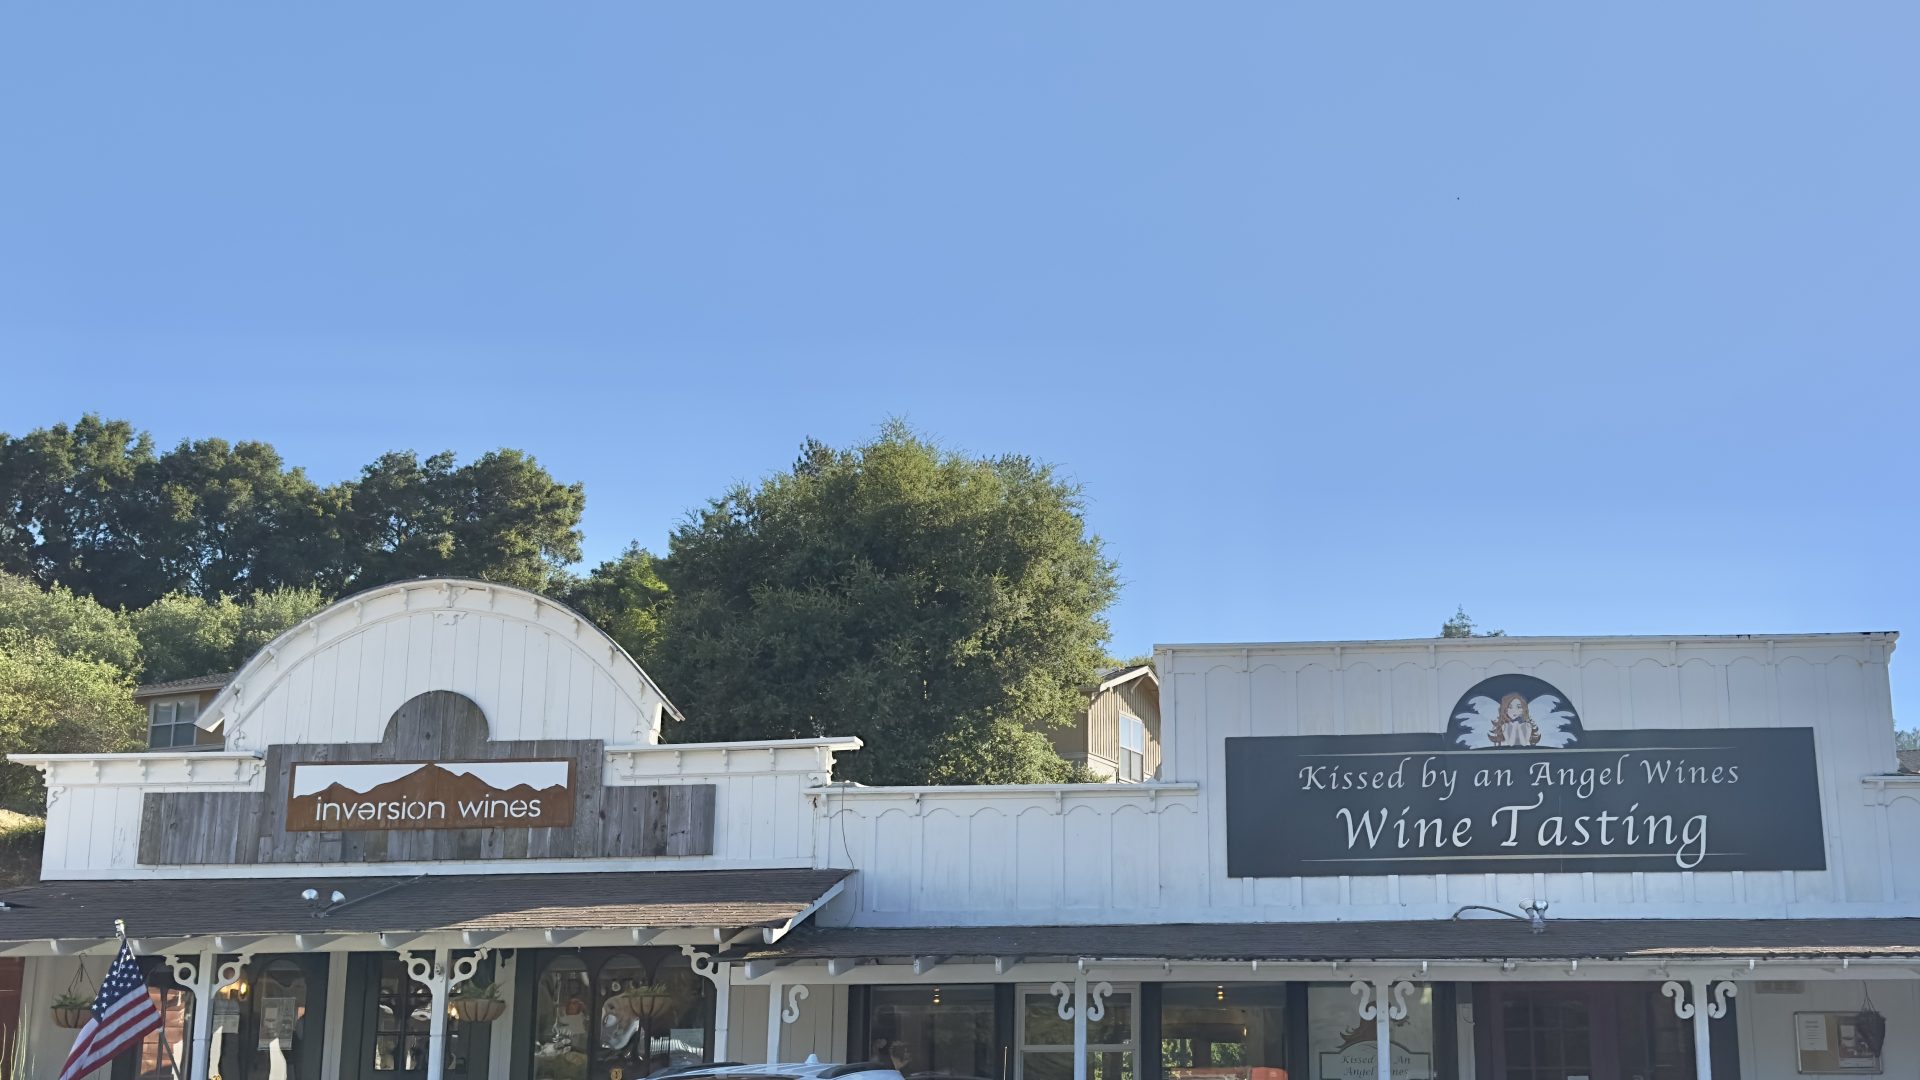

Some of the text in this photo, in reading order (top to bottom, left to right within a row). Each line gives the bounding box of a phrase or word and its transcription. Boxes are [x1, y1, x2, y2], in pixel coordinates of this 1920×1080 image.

[1299, 754, 1740, 800] Kissed by an Angel Wines
[458, 793, 542, 818] wines
[1336, 792, 1709, 869] Wine Tasting
[1342, 1055, 1411, 1065] Kissed An
[1344, 1067, 1375, 1079] Angel
